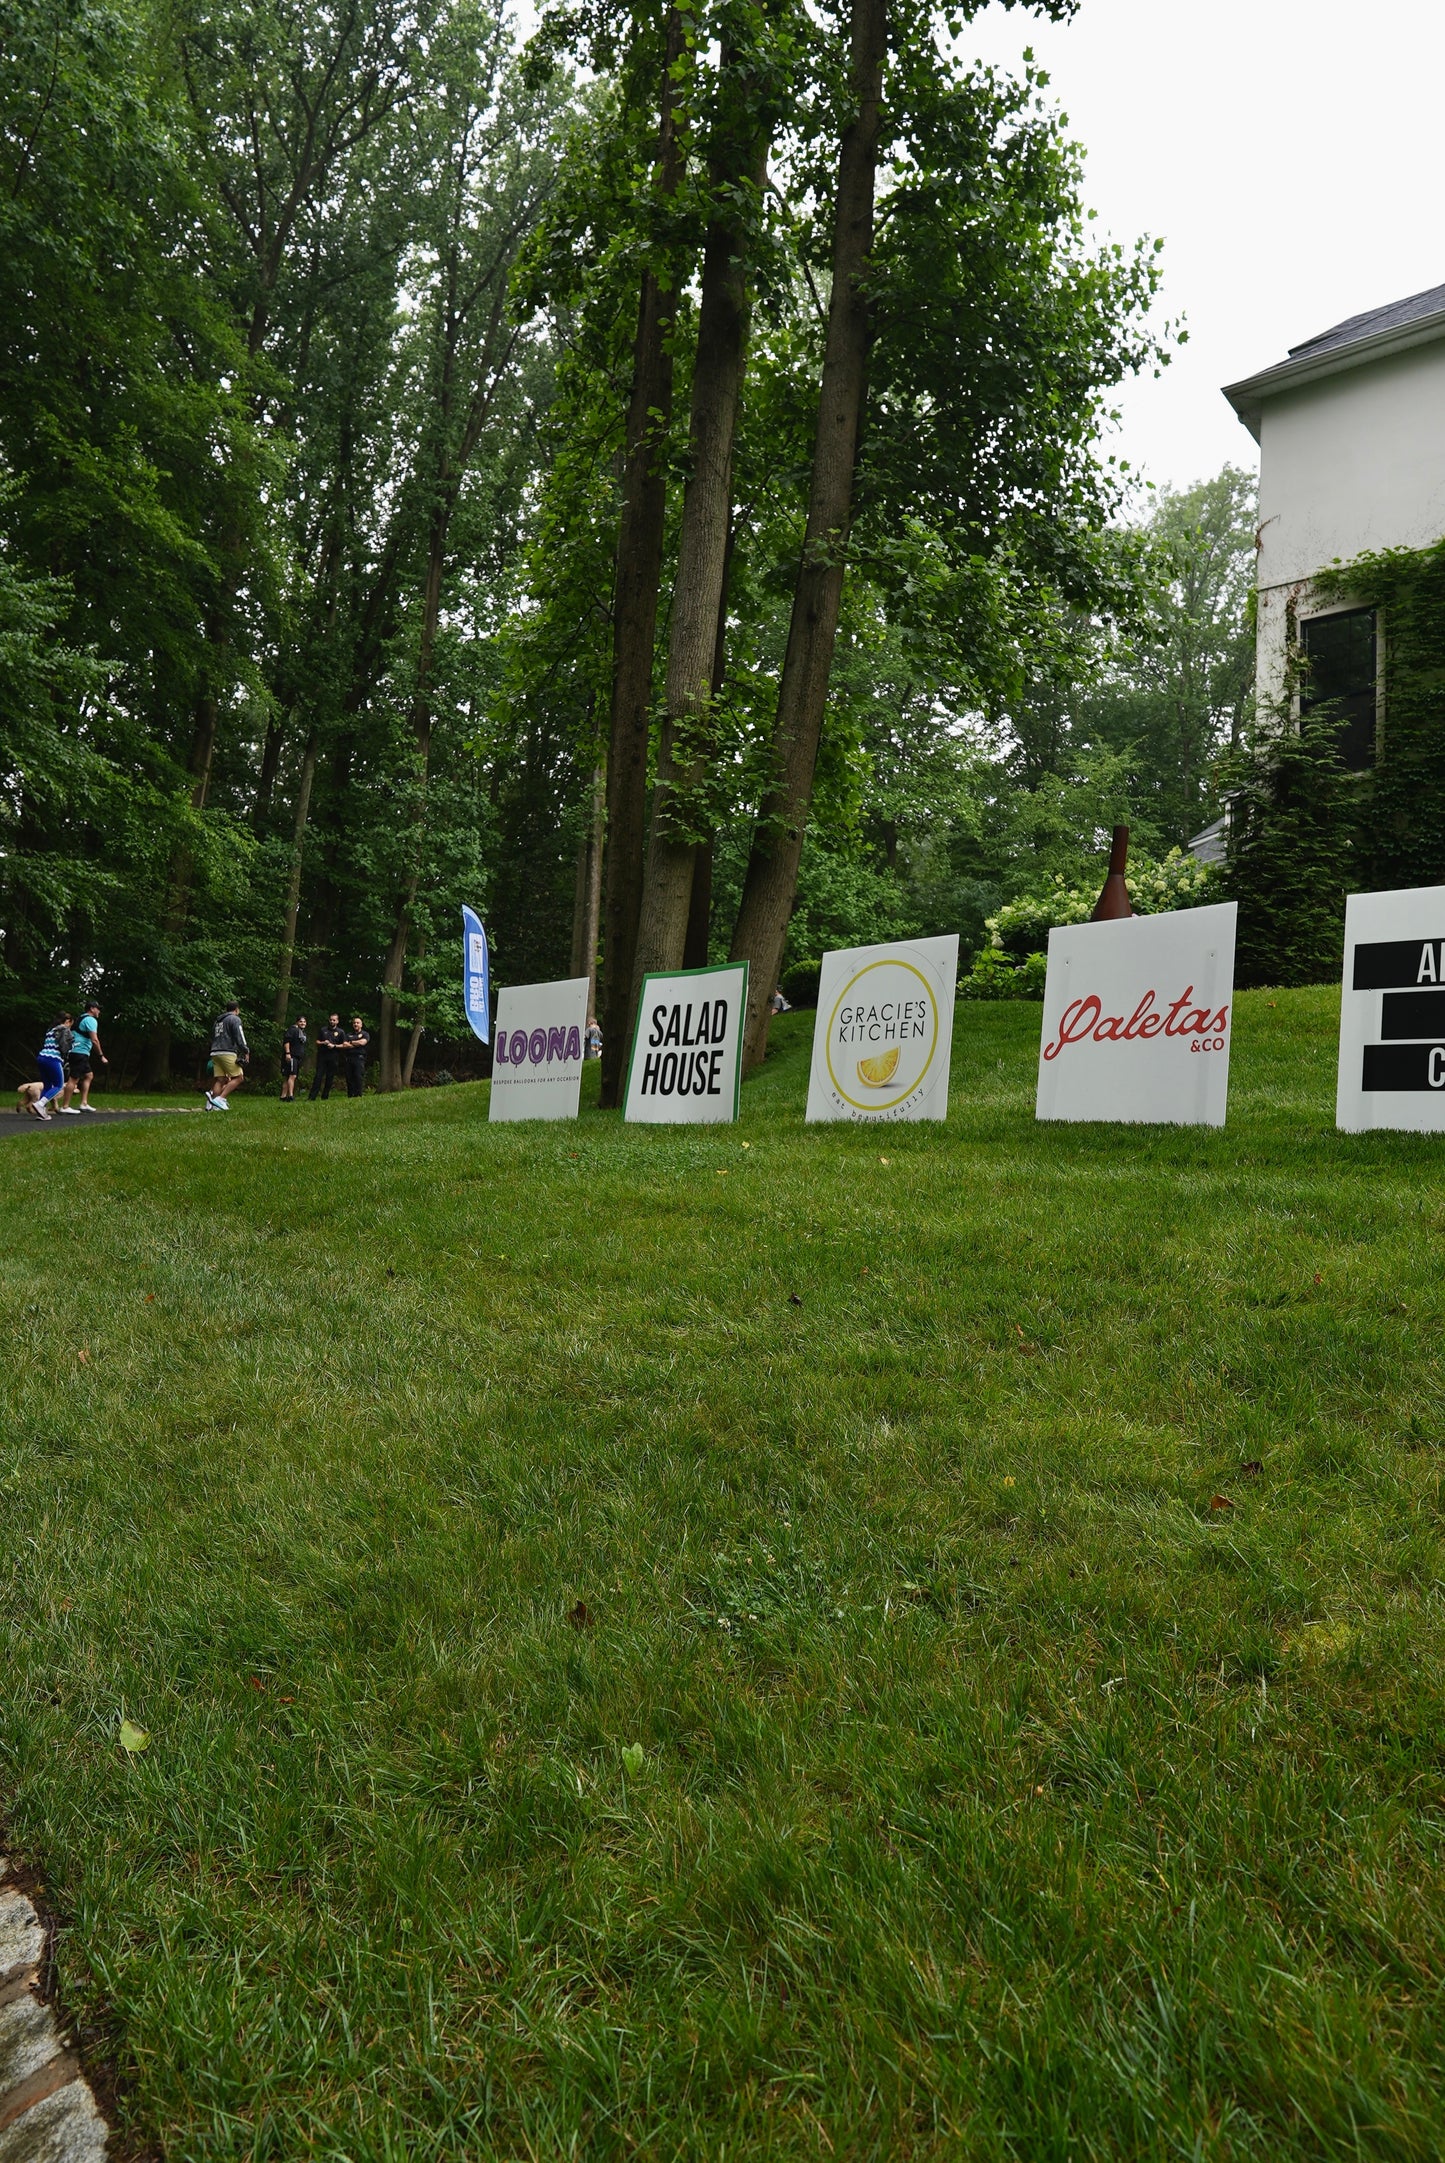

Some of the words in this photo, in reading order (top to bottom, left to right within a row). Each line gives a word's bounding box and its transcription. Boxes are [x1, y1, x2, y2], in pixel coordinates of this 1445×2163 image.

[649, 1000, 728, 1047] SALAD
[840, 1000, 926, 1024] GRACIE'S
[1043, 985, 1229, 1061] Paletas
[496, 1026, 581, 1065] LOONA
[839, 1021, 925, 1043] KITCHEN
[1190, 1037, 1225, 1052] &CO
[641, 1050, 724, 1095] HOUSE
[831, 1092, 845, 1109] eat
